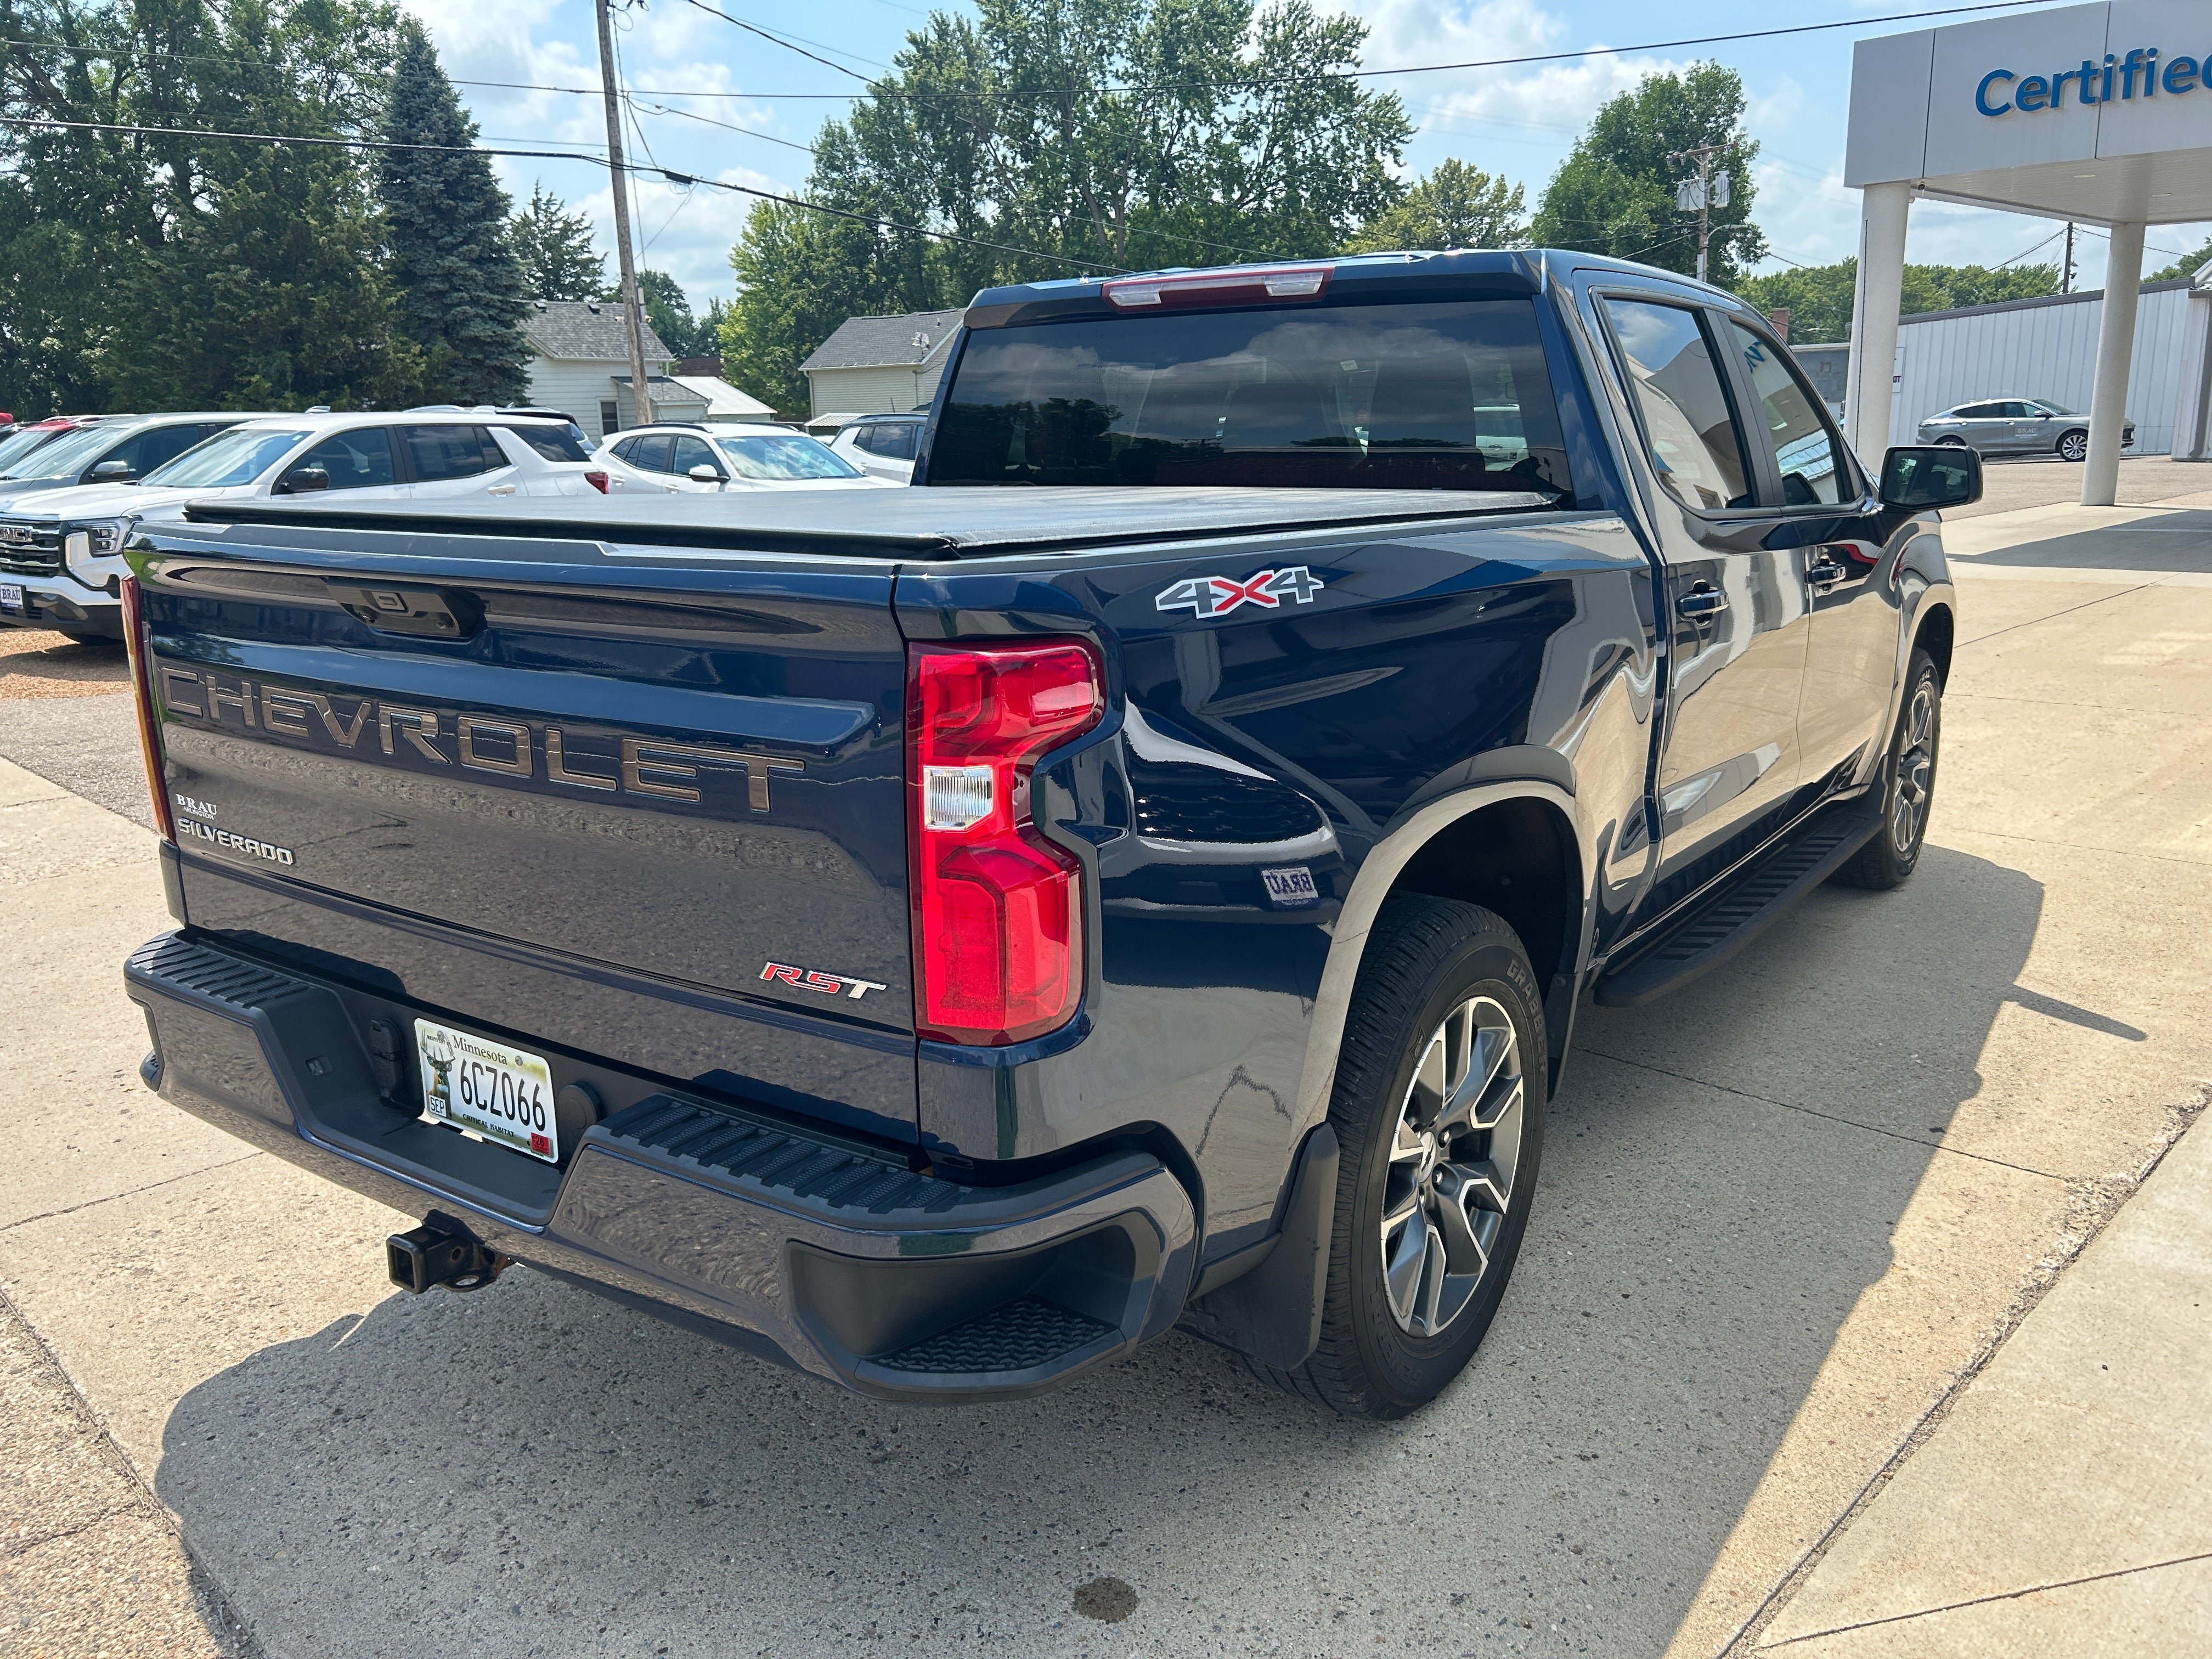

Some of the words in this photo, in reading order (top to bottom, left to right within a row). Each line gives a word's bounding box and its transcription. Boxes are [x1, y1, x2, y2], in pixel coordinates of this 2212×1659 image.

[2, 588, 20, 601] BRAU
[162, 667, 805, 814] CHEVROLET
[176, 793, 217, 815] BRAU
[183, 805, 215, 820] ARLINGTON
[178, 817, 295, 865] SILVERADO
[759, 962, 887, 999] RST
[452, 1035, 508, 1065] Minnesota
[430, 1097, 445, 1114] SEP
[460, 1058, 546, 1132] 6CZ066
[462, 1114, 489, 1128] CRITICAL
[489, 1124, 515, 1138] HABITAT
[535, 1136, 545, 1147] 26
